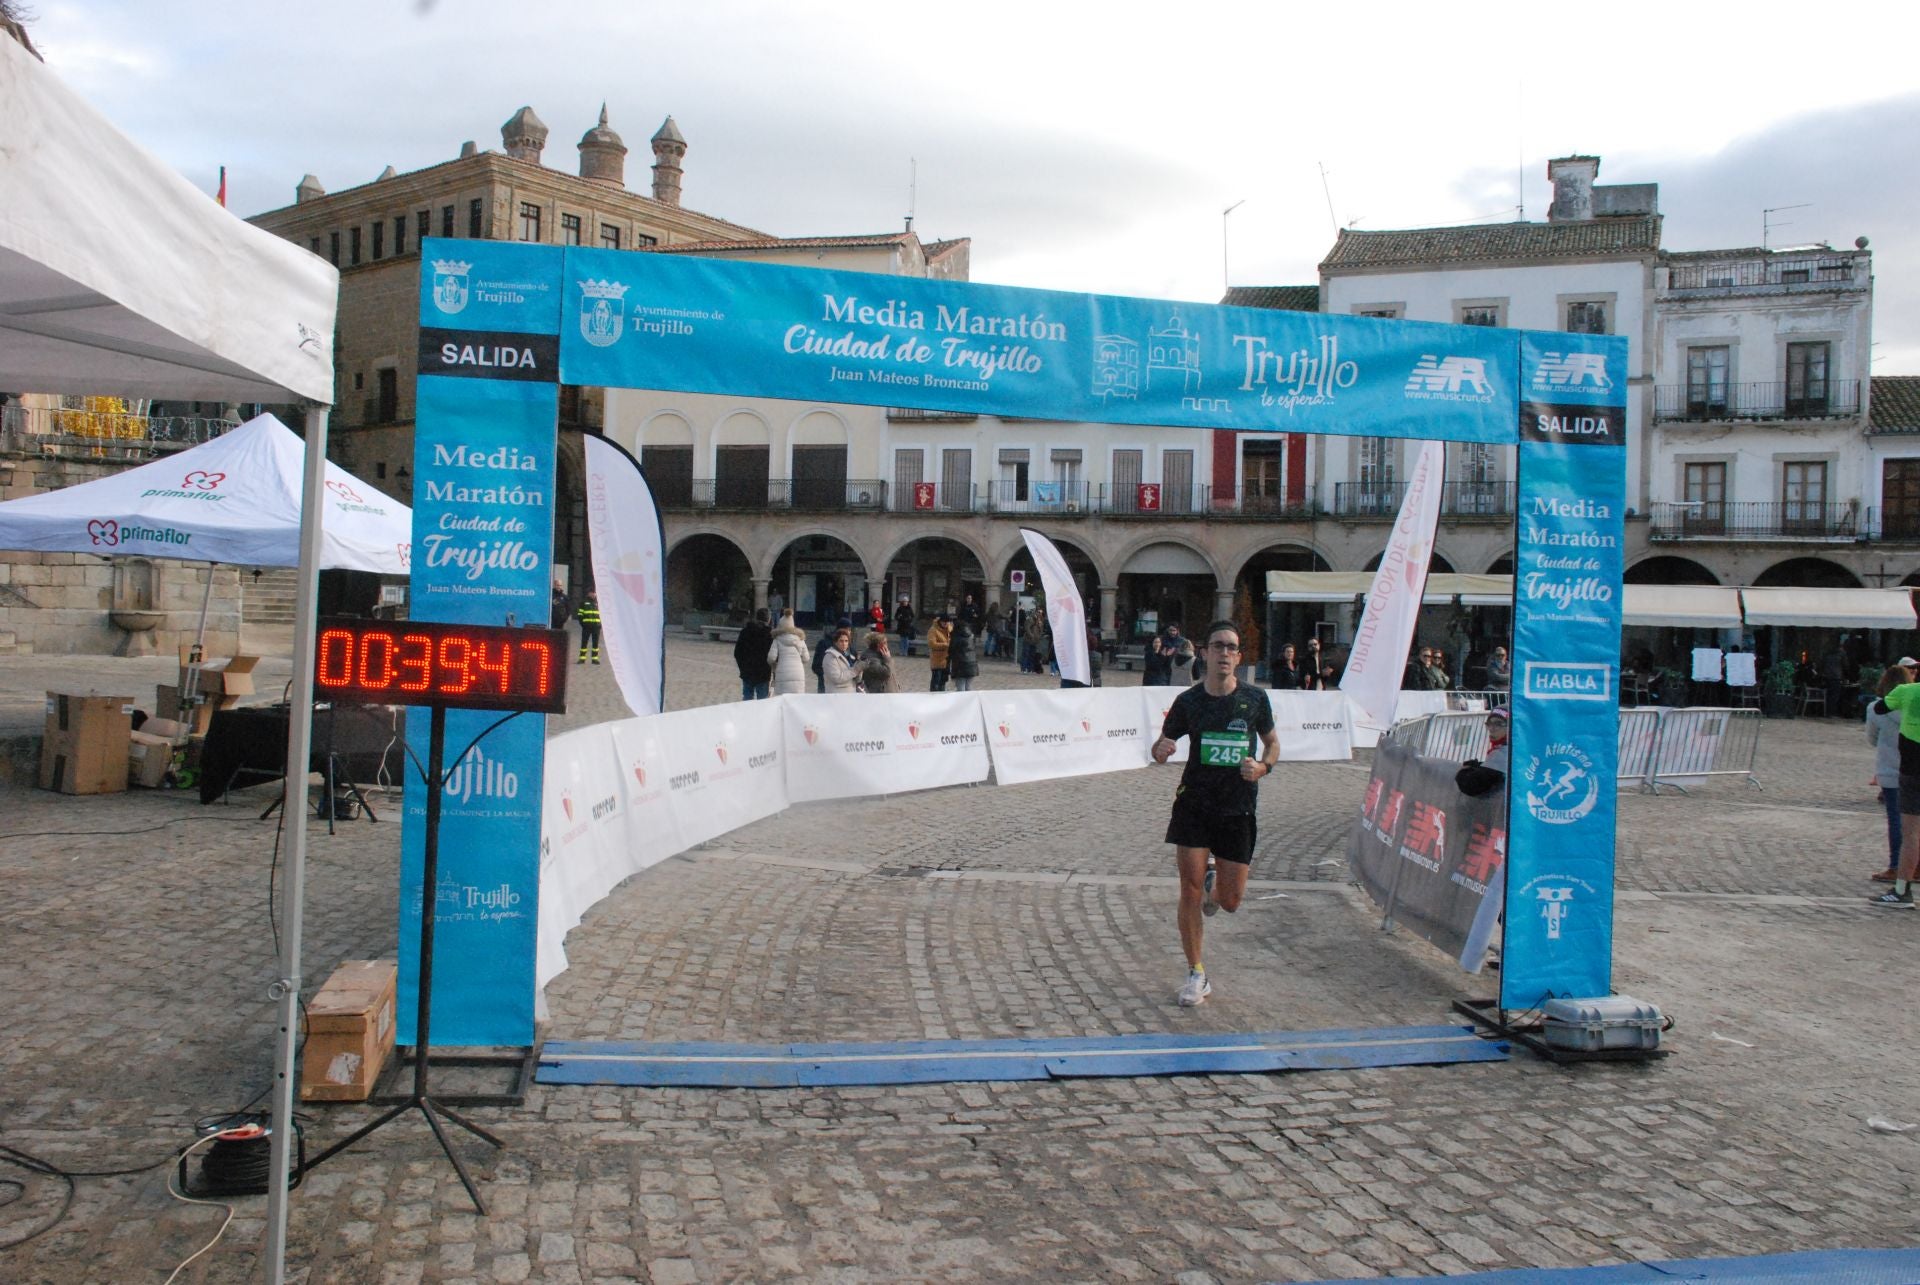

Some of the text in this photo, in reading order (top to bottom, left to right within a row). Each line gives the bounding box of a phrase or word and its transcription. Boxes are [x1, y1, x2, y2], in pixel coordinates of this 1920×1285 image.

[476, 279, 550, 292] Ayuntamiento de
[475, 290, 525, 305] Trujillo
[634, 304, 725, 321] Ayuntamiento de
[822, 293, 1067, 342] Media Maratón
[632, 317, 694, 337] Trujillo
[440, 343, 537, 369] SALIDA
[783, 324, 1043, 380] Ciudad de Trujillo
[1232, 334, 1359, 399] Trujillo
[829, 366, 989, 392] Juan Mateos Broncano
[1532, 383, 1610, 395] www.musicrun.es
[1261, 386, 1275, 406] te
[1404, 390, 1492, 403] www.musicrun.es
[1537, 414, 1609, 435] SALIDA
[433, 443, 537, 471] Media
[141, 488, 226, 502] primaflor
[424, 480, 544, 506] Maratón
[1532, 496, 1610, 519] Media
[439, 512, 526, 533] Ciudad de
[120, 527, 192, 546] primaflor
[1527, 527, 1616, 548] Maratón
[423, 534, 539, 580] Trujillo
[1536, 553, 1600, 570] Ciudad de
[426, 583, 535, 596] Juan Mateos Broncano
[1525, 571, 1612, 610] Trujillo
[319, 629, 549, 696] 00:39:47
[1535, 673, 1597, 690] HABLA
[1209, 746, 1241, 764] 245
[1525, 742, 1593, 781] Club Atletismo
[441, 745, 518, 805] ujillo
[462, 884, 521, 909] Trujillo
